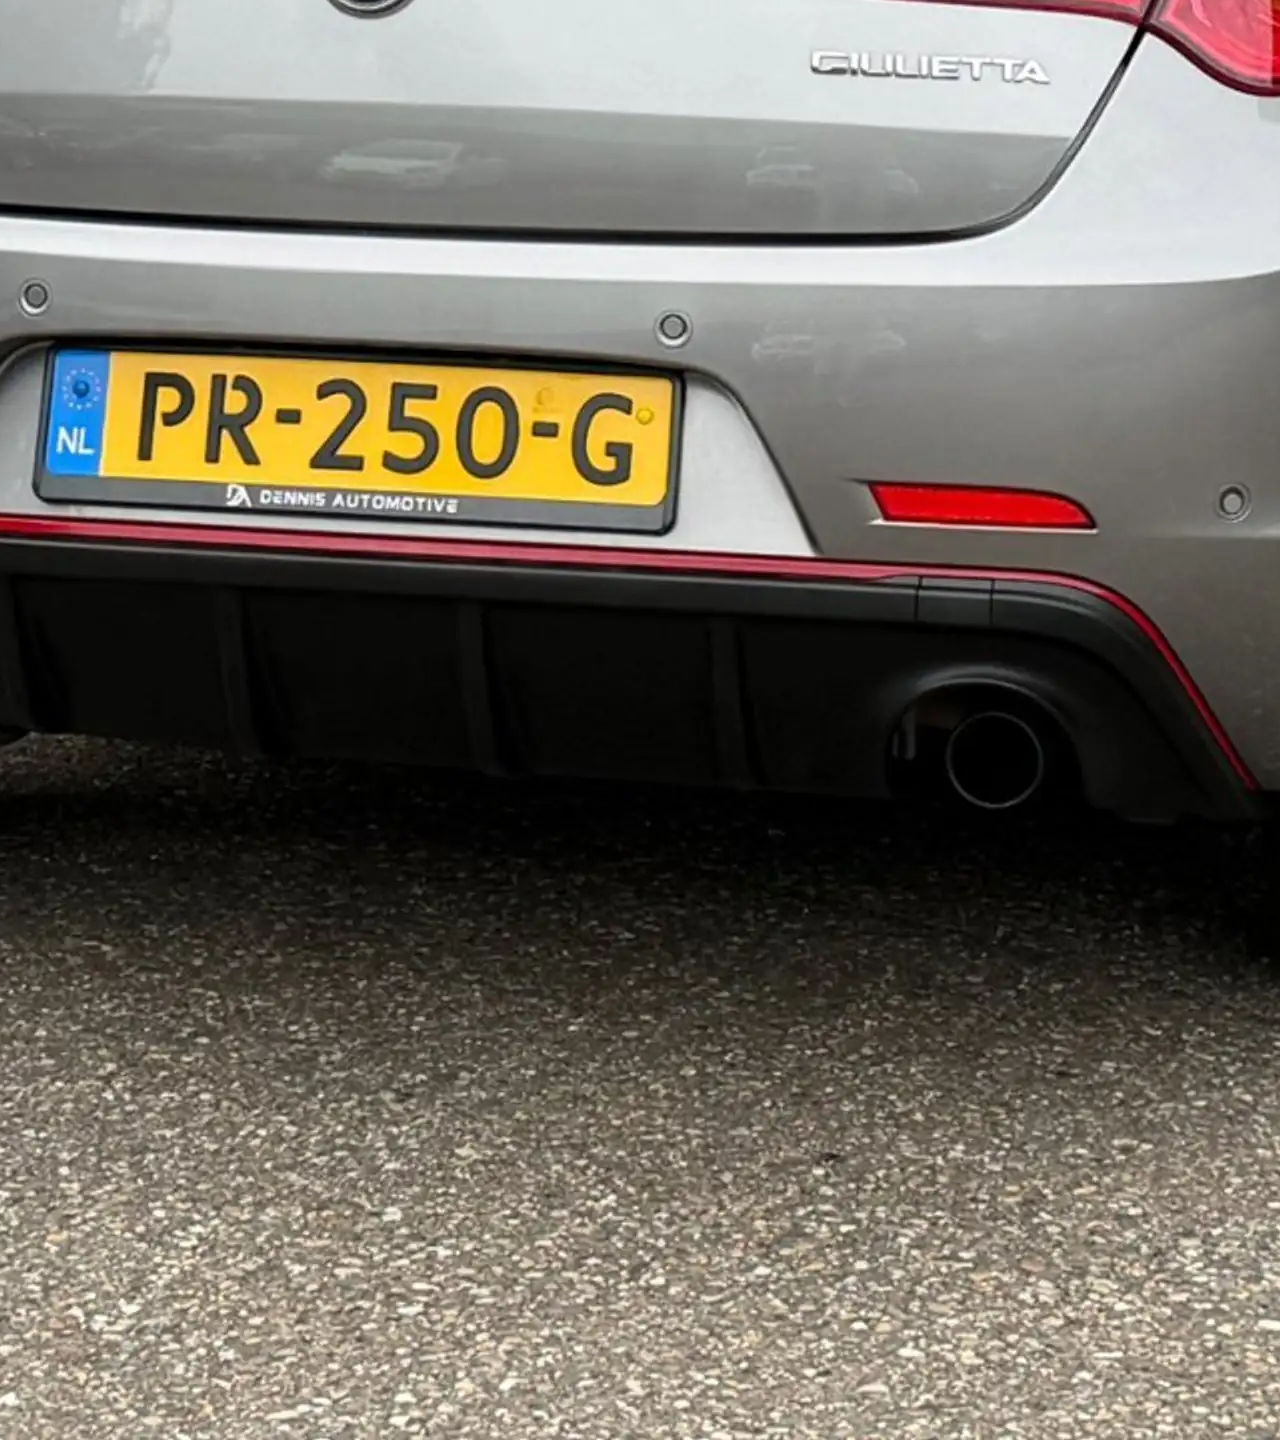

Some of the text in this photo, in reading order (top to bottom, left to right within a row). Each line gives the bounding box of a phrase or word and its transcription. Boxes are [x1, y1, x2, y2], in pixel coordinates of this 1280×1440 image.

[810, 50, 1051, 85] GIULIETTA
[56, 426, 95, 455] NL
[137, 371, 634, 487] PR-250-G
[259, 489, 325, 507] DENNIS
[331, 492, 459, 514] AUTOMOTIVE
